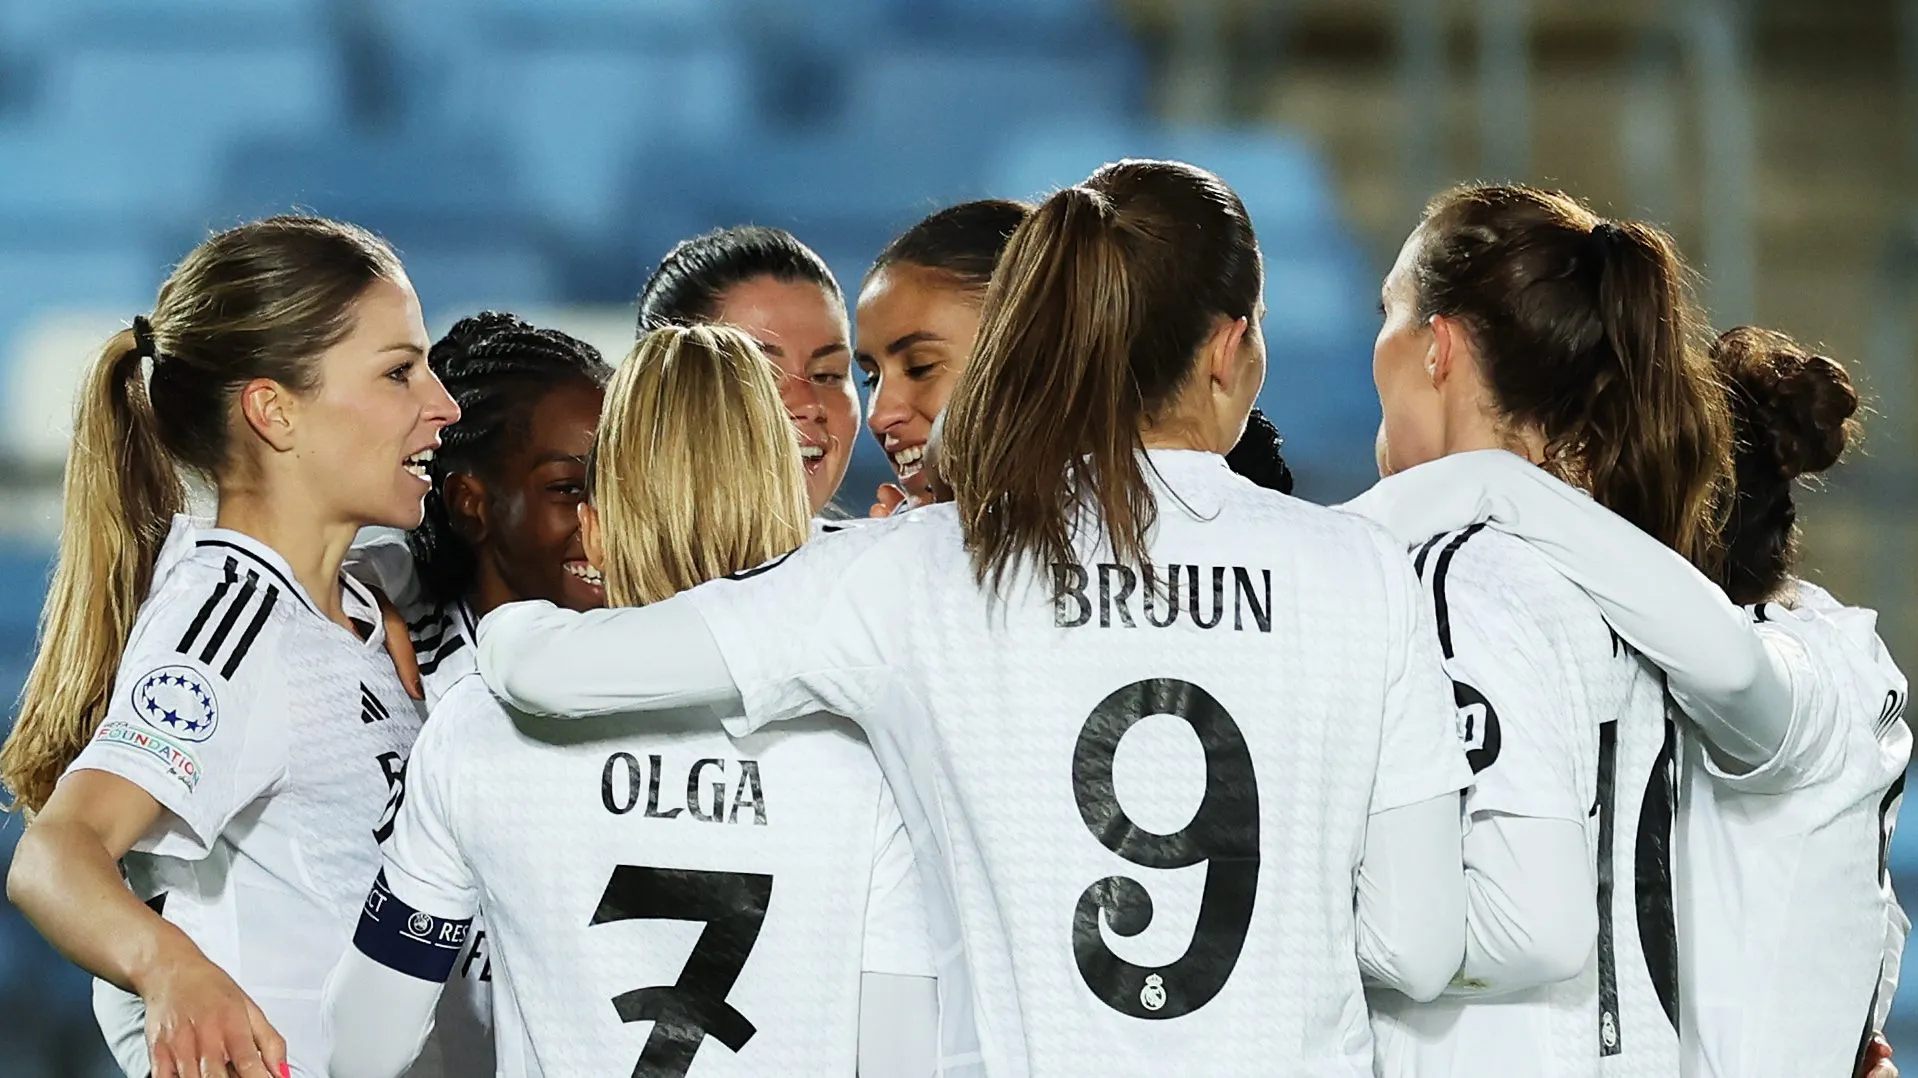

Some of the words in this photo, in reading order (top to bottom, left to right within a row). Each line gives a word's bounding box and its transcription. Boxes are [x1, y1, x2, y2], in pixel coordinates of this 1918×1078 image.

[1051, 563, 1272, 633] BRUUN
[97, 727, 200, 787] FOUNDATION
[601, 751, 768, 826] OLGA
[1072, 677, 1261, 1021] 9
[589, 864, 774, 1078] 7
